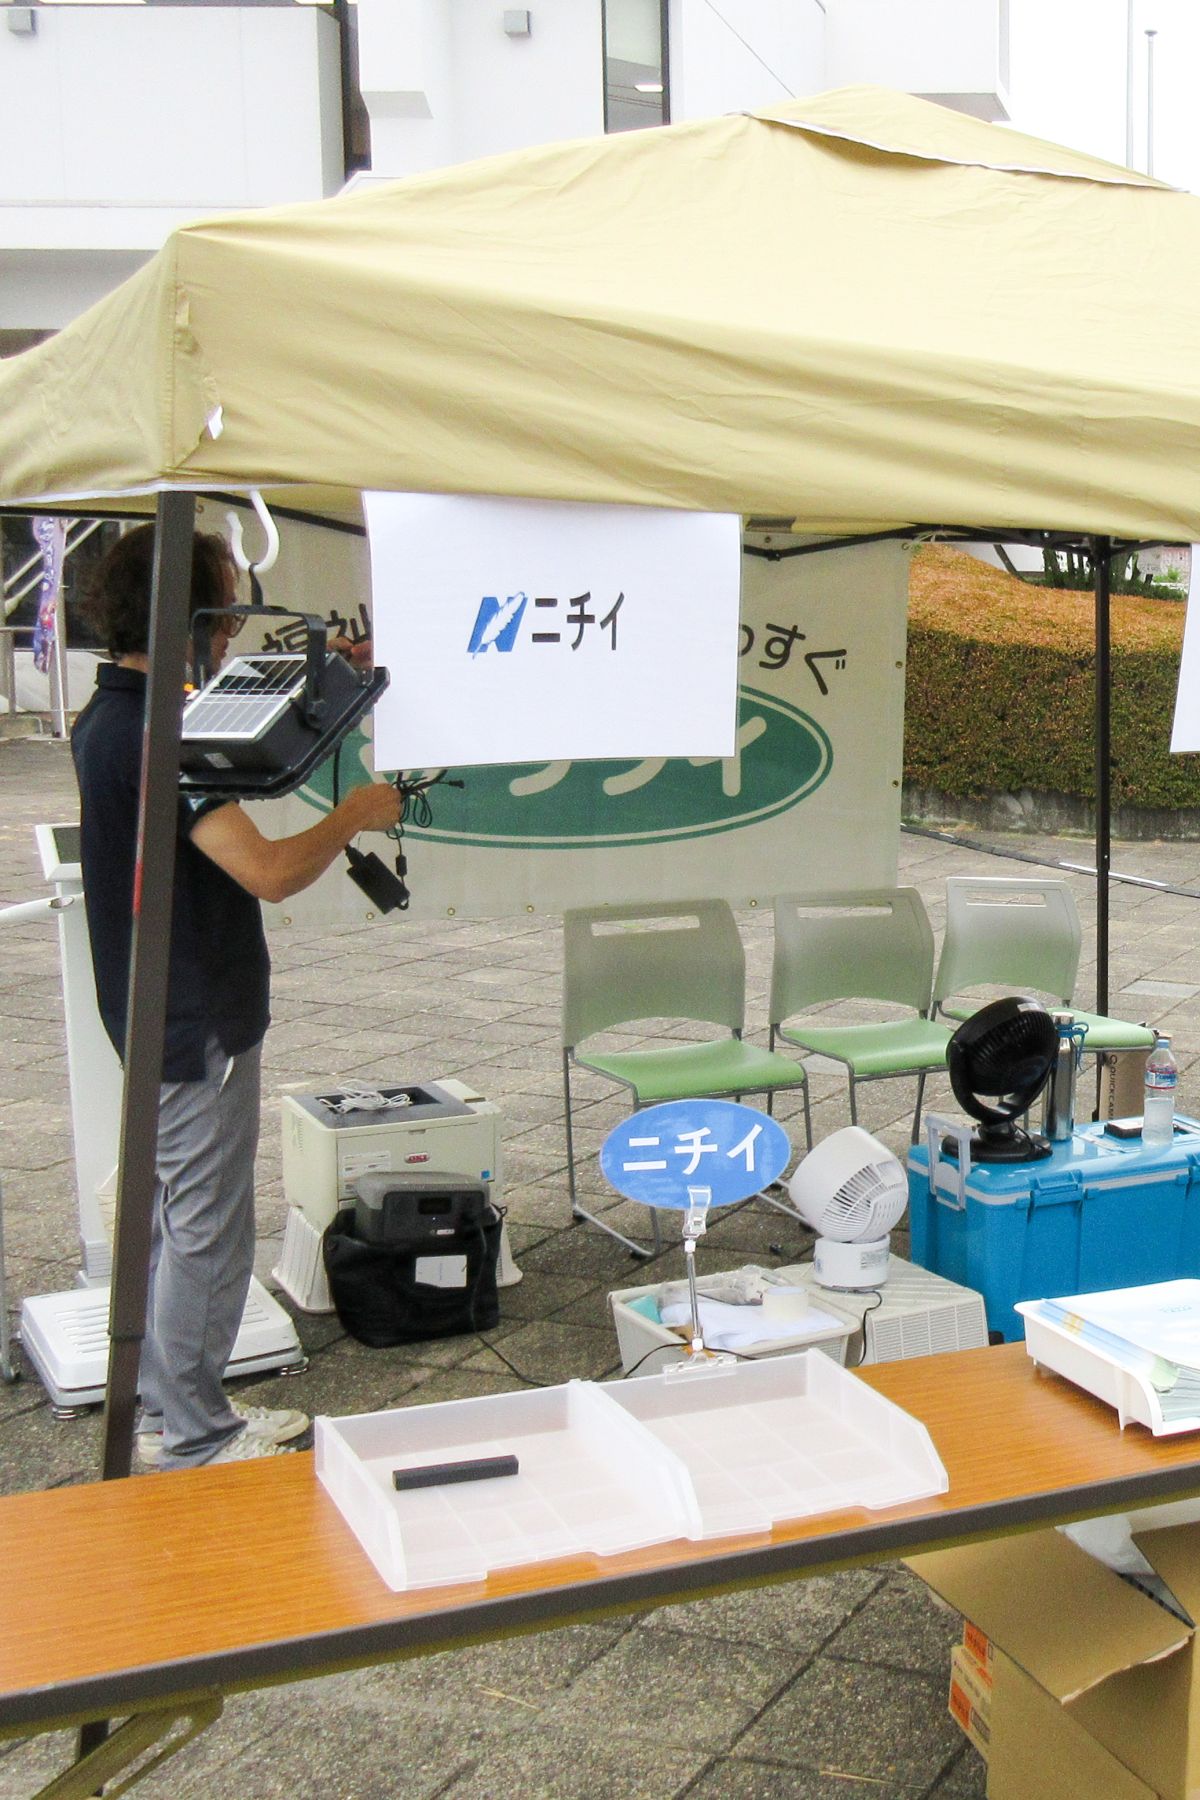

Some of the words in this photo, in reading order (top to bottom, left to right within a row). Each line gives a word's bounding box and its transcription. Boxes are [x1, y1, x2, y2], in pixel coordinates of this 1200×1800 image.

[532, 591, 625, 651] ニチイ
[623, 1123, 763, 1175] ニチイ
